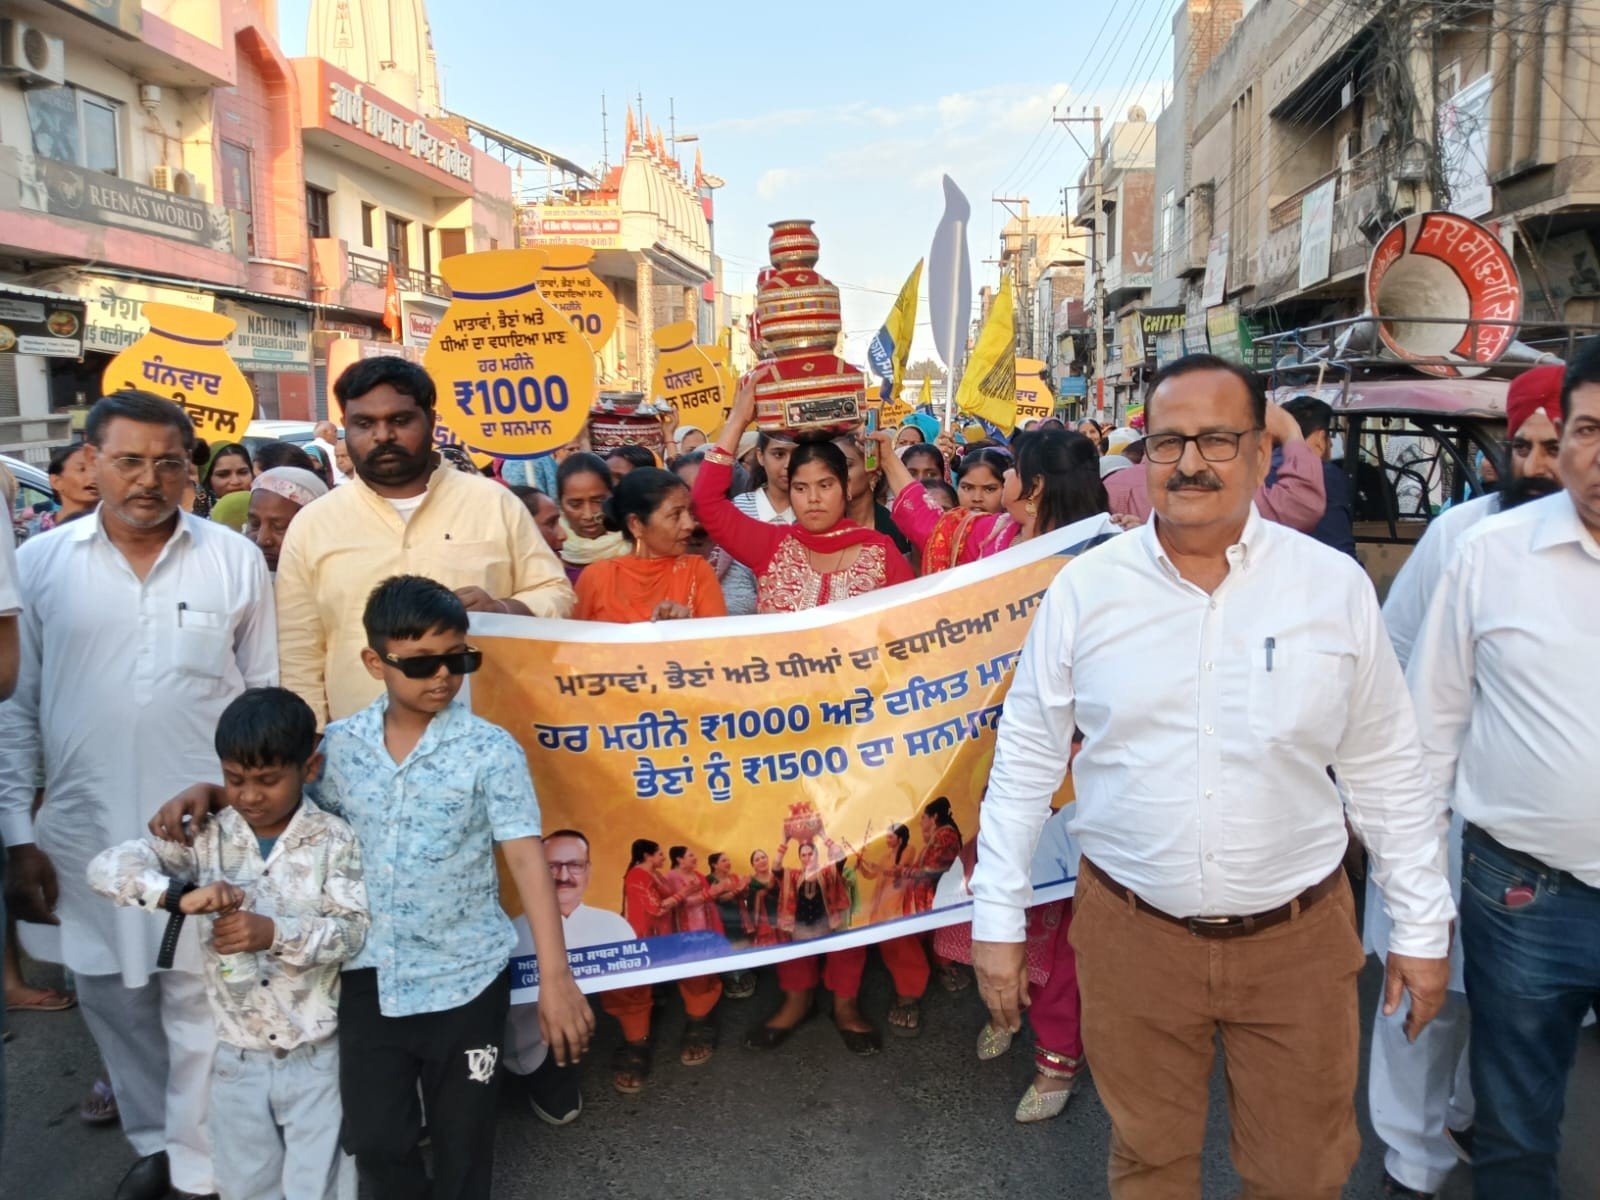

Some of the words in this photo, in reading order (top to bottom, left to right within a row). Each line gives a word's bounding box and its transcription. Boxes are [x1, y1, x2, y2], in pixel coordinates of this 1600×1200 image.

[90, 185, 149, 218] REENA'S
[152, 203, 204, 231] WORLD
[1422, 216, 1468, 254] जय
[247, 315, 298, 338] NATIONAL
[454, 311, 495, 332] ਮਾਤਾਵਾਂ,
[497, 309, 520, 329] ਭੈਣਾਂ
[523, 308, 545, 326] ਅਤੇ
[440, 335, 469, 353] ਧੀਆਂ
[472, 337, 485, 350] ਦਾ
[488, 331, 539, 349] ਵਧਾਇਆ
[542, 331, 568, 345] ਮਾਣ
[477, 359, 498, 373] ਹਰ
[500, 352, 535, 372] ਮਹੀਨੇ
[142, 355, 222, 395] ਧੰਨਵਾਦ
[663, 367, 704, 389] ਧੰਨਵਾਦ
[453, 374, 570, 415] ₹1000
[680, 384, 721, 409] ਸਰਕਾਰ
[1016, 404, 1050, 418] ਰਕਾਰ
[480, 422, 497, 437] ਦਾ
[501, 419, 552, 437] ਸਨਮਾਨ
[555, 665, 657, 696] ਮਾਤਾਵਾਂ,
[664, 660, 714, 690] ਭੈਣਾਂ
[722, 656, 769, 684] ਅਤੇ
[776, 648, 842, 677] ਧੀਆਂ
[849, 647, 878, 670] ਦਾ
[885, 608, 999, 661] ਵਧਾਇਆ
[534, 723, 589, 752] ਹਰ
[599, 710, 689, 751] ਮਹੀਨੇ
[700, 704, 811, 742] ₹1000
[820, 688, 874, 726] ਅਤੇ
[884, 669, 969, 715] ਦਲਿਤ
[633, 755, 694, 798] ਭੈਣਾਂ
[704, 751, 732, 801] ਨੂੰ
[742, 746, 849, 785] ₹1500
[857, 737, 894, 767] ਦਾ
[622, 942, 649, 955] MLA
